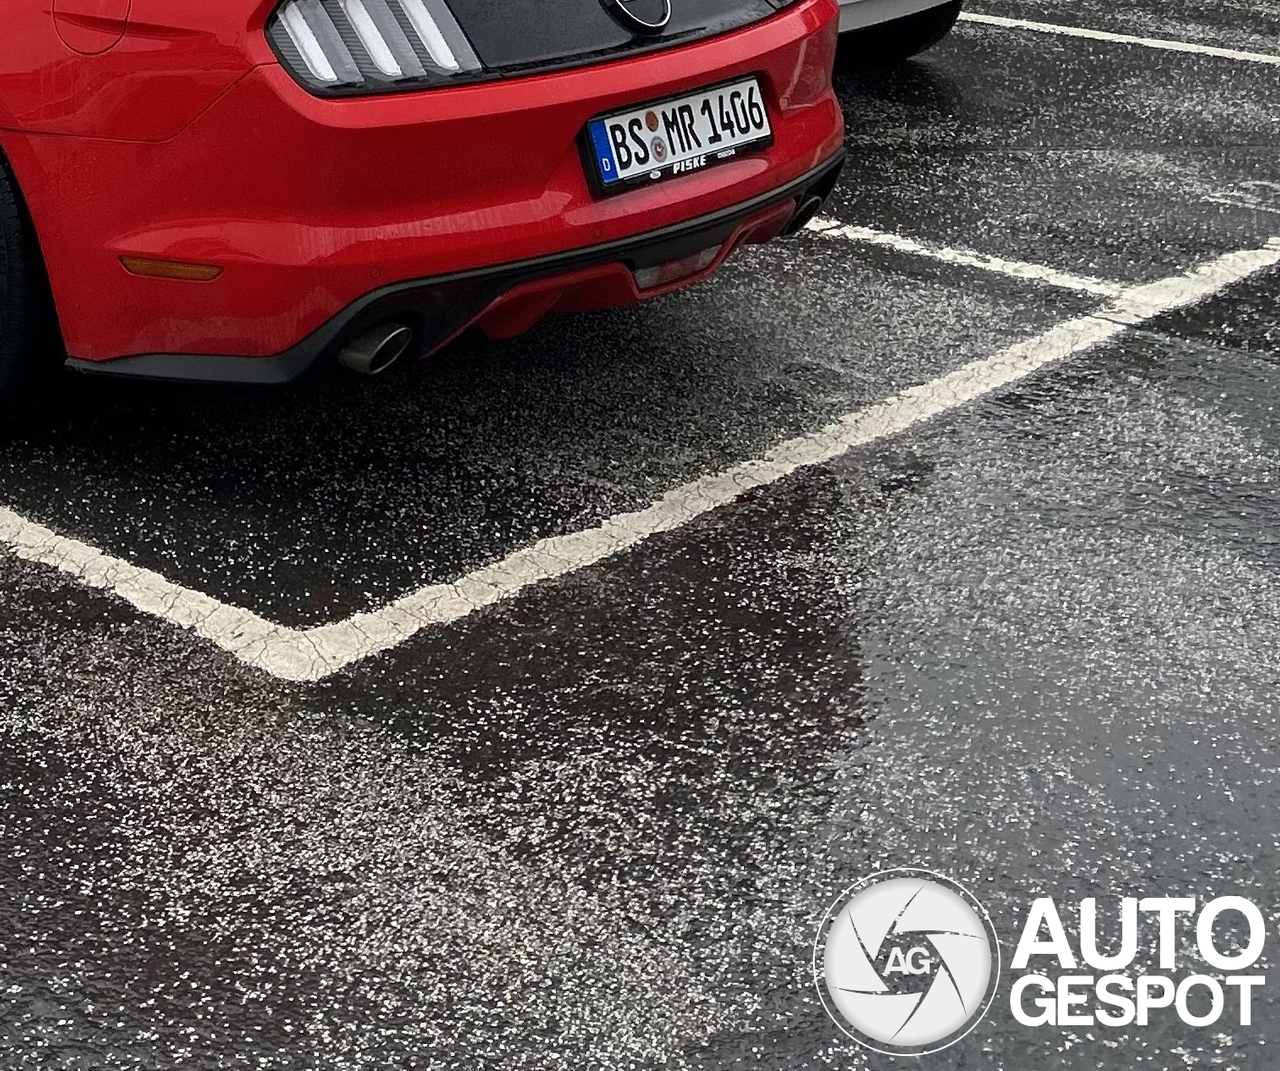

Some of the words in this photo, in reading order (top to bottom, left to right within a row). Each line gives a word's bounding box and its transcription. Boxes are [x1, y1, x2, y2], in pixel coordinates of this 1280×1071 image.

[610, 118, 650, 170] BS
[661, 104, 701, 155] MR
[700, 86, 764, 144] 1406
[602, 158, 611, 172] D
[672, 154, 707, 174] PISKE
